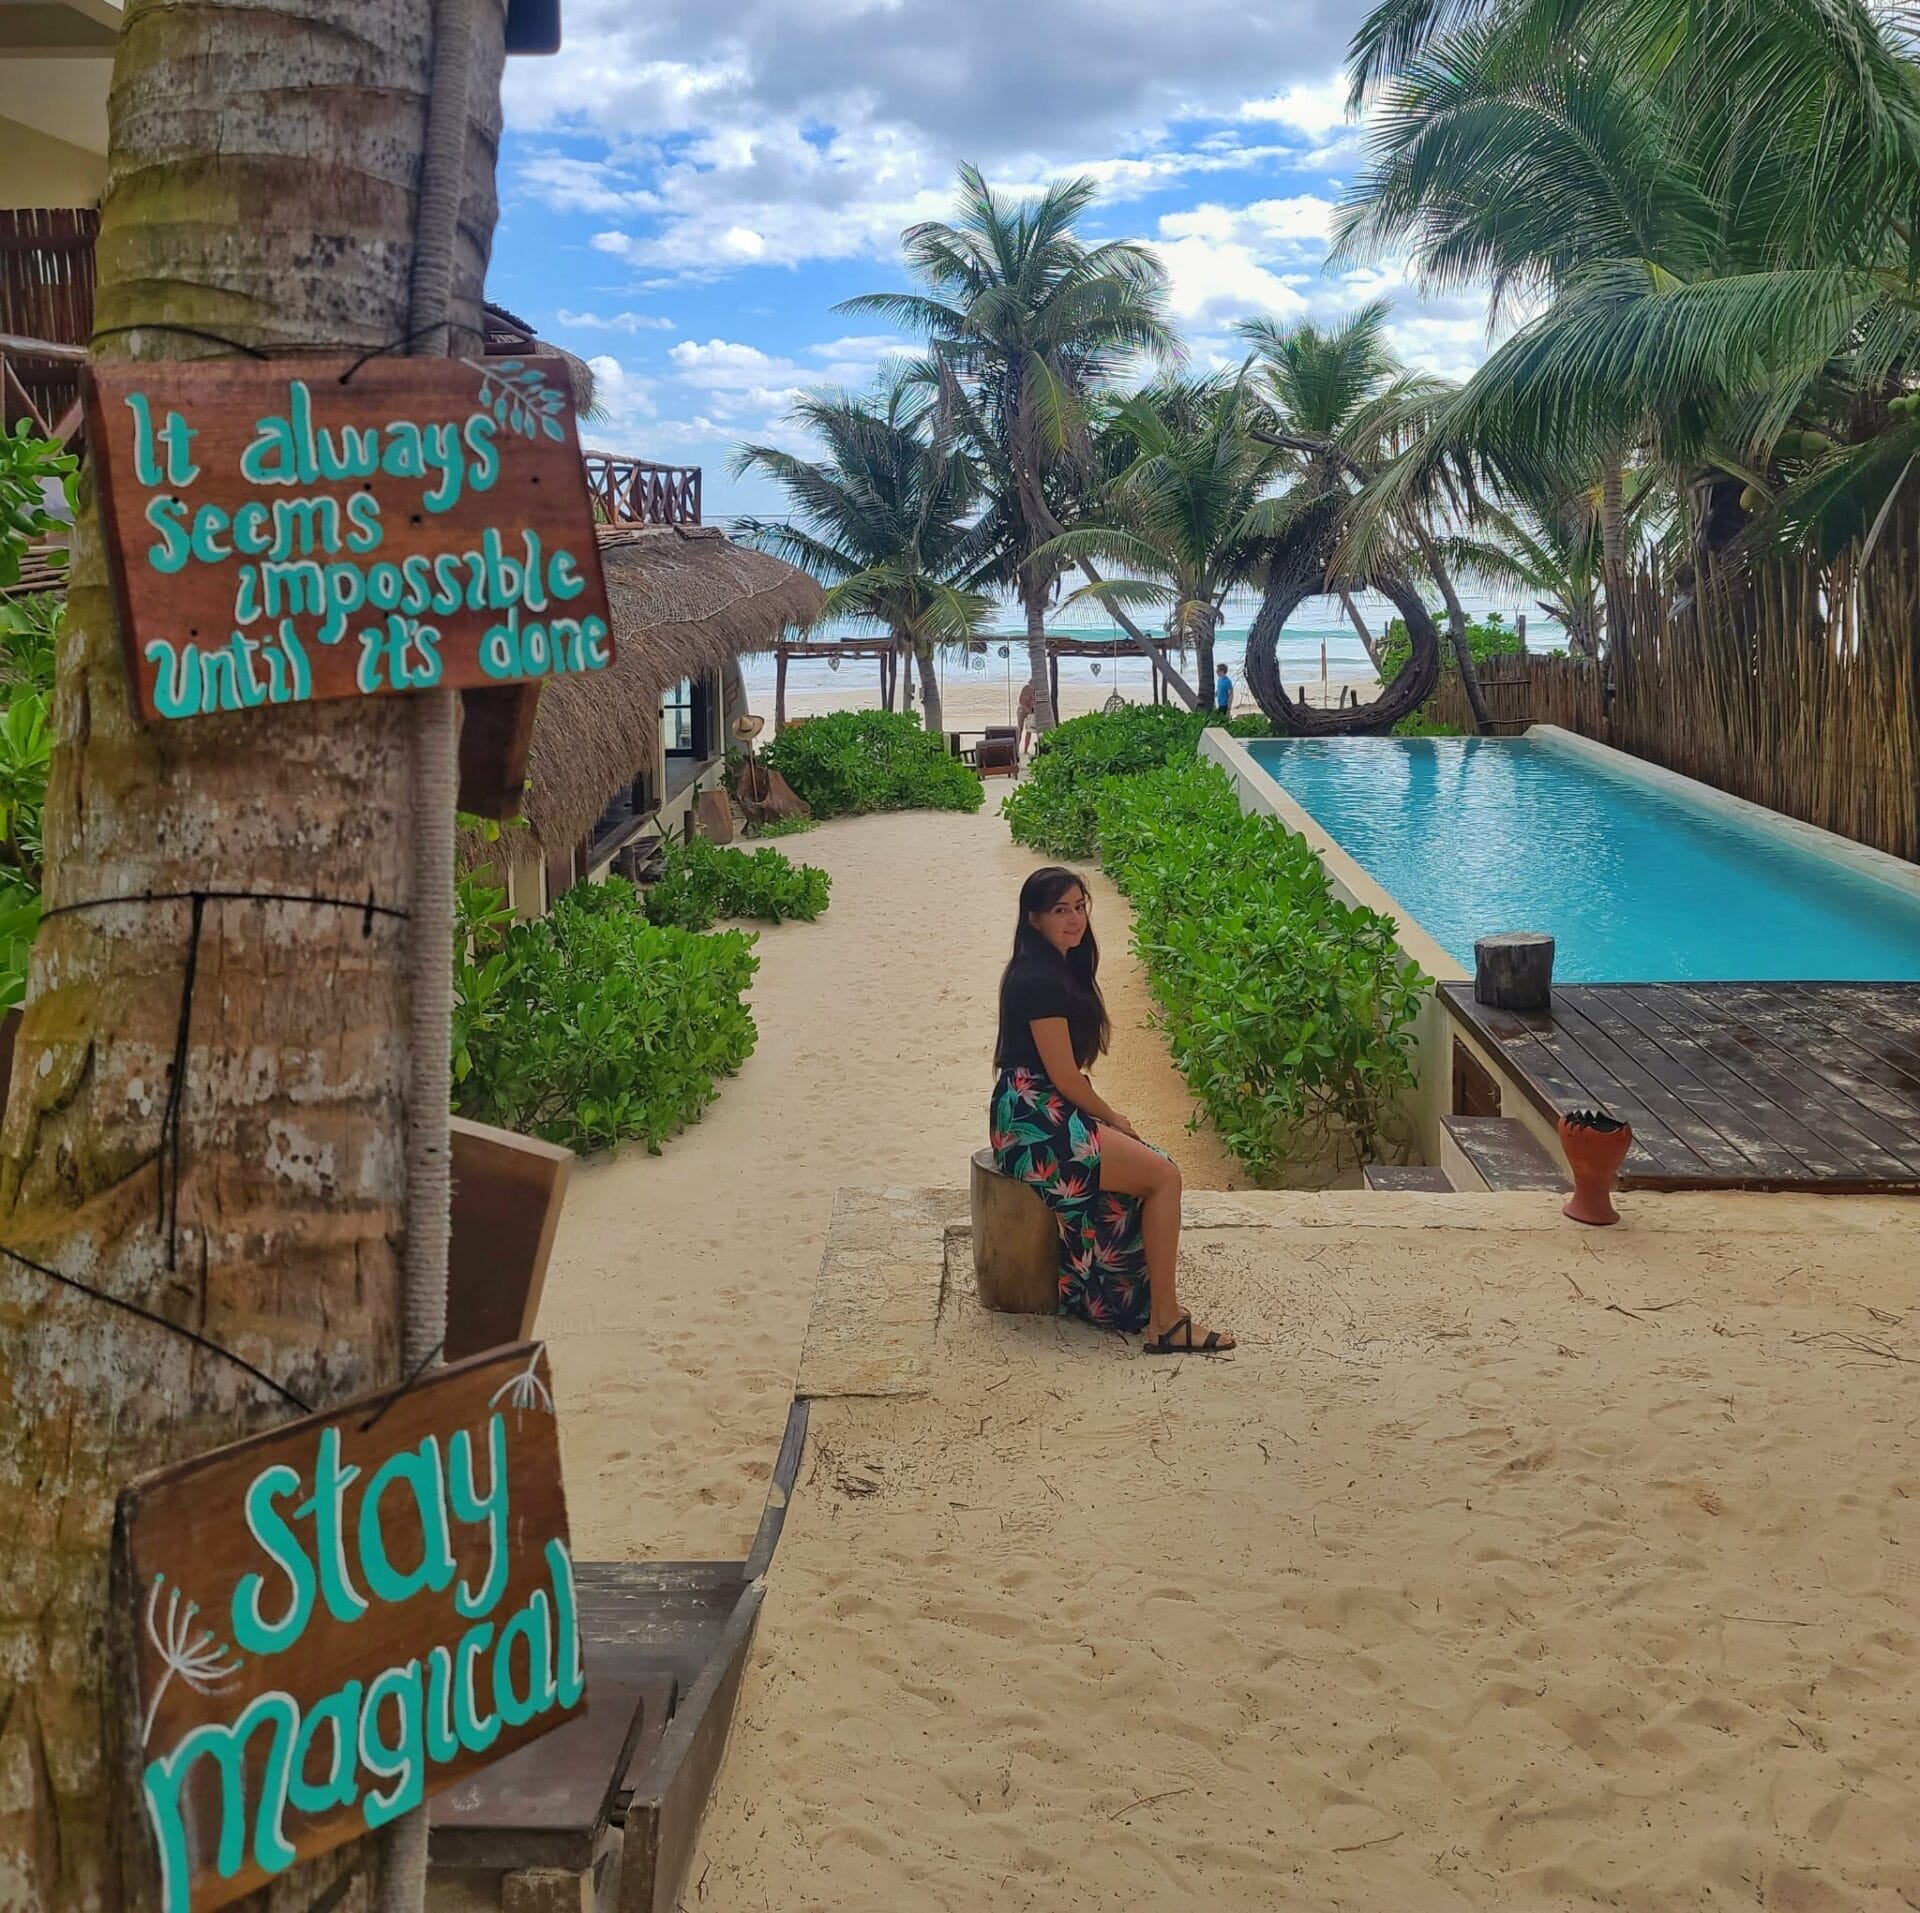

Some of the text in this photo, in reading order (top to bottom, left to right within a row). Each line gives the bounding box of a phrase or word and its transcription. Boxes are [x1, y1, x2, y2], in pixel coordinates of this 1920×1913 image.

[126, 380, 499, 513] It always
[235, 528, 585, 644] impossible
[479, 608, 610, 680] done
